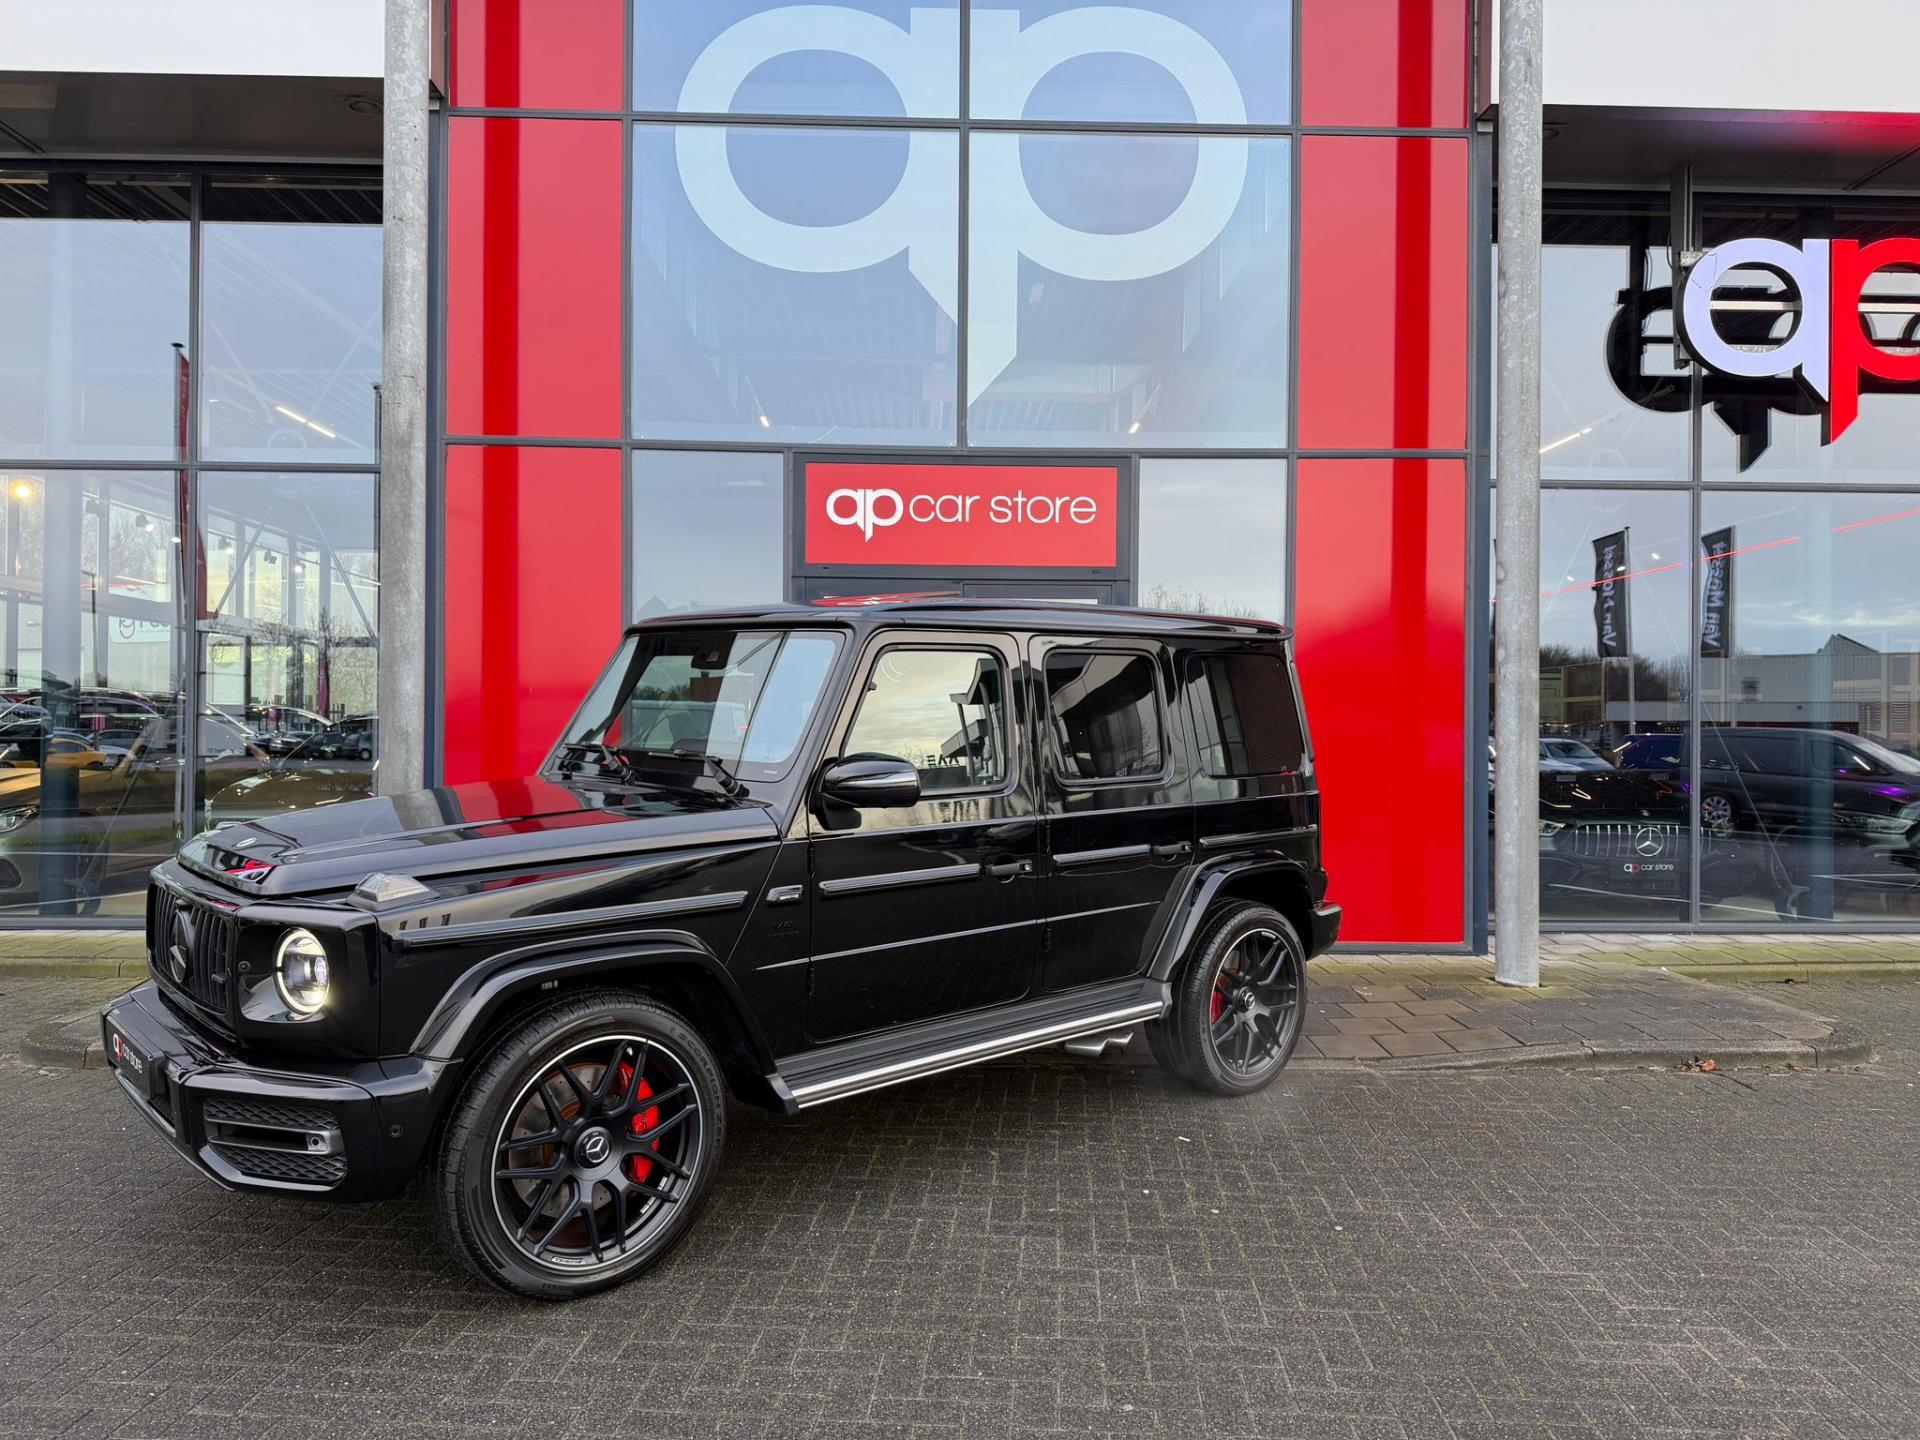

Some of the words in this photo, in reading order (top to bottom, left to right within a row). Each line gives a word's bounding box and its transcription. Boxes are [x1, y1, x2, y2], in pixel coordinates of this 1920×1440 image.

[675, 4, 1248, 408] ap
[826, 488, 904, 543] ap
[909, 494, 981, 523] car
[989, 489, 1097, 524] store
[1655, 863, 1674, 871] store
[678, 1033, 722, 1108] SCORPION
